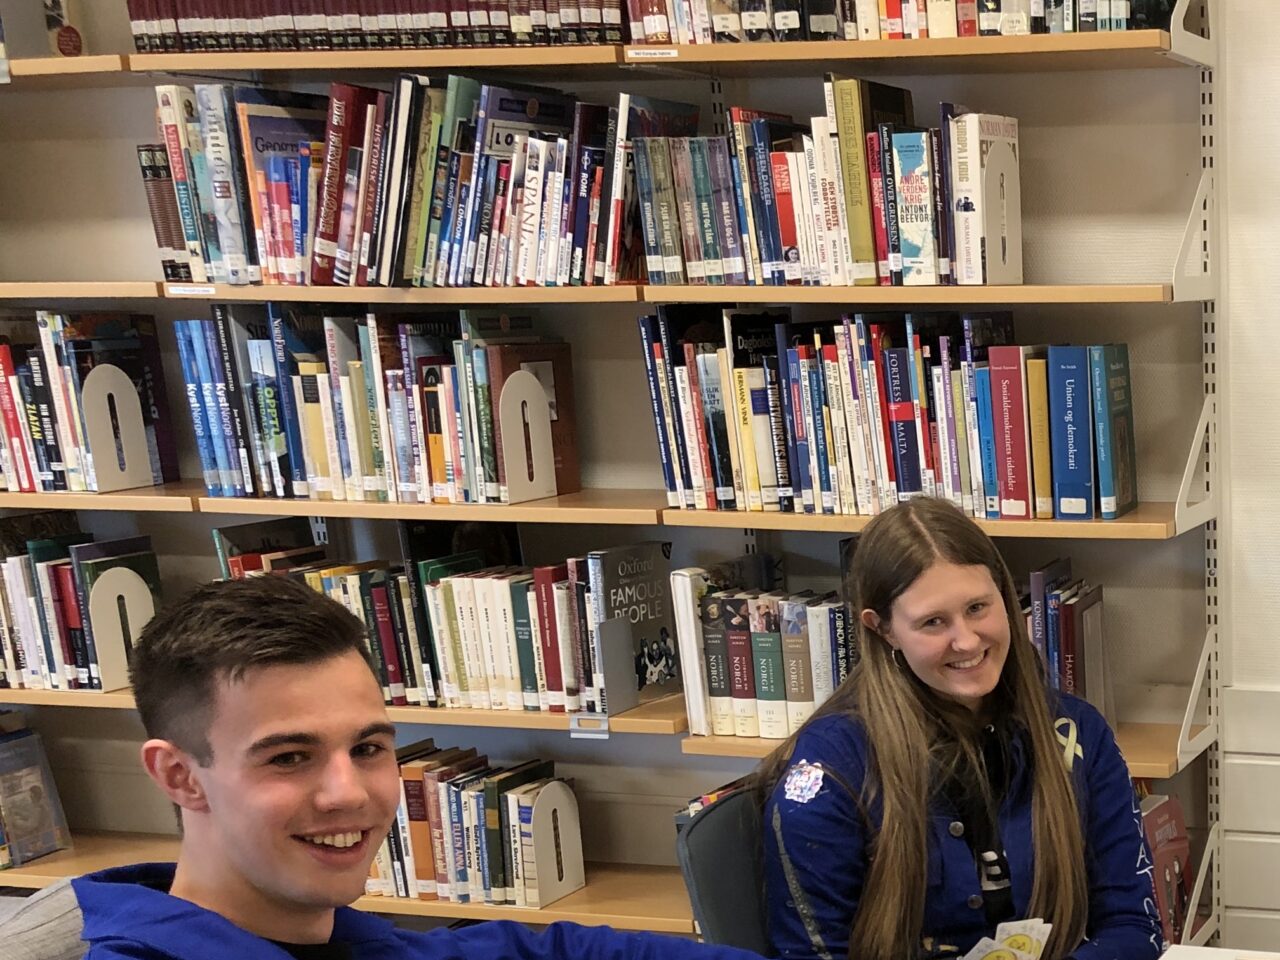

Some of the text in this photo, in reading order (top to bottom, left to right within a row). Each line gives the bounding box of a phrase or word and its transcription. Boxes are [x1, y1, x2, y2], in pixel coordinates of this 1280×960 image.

[578, 172, 589, 198] ROME
[757, 142, 772, 206] TUSEN DAGER
[778, 164, 790, 193] ANNE
[887, 177, 896, 204] OVER
[900, 174, 925, 185] ANDRE
[177, 184, 195, 235] HISTORIE
[447, 176, 456, 209] London
[900, 204, 928, 214] ANTONY
[904, 194, 923, 205] KRIG
[454, 203, 466, 240] LONDON
[889, 204, 899, 247] GRENSEN?
[900, 213, 930, 223] BEEVOR
[326, 328, 336, 358] ERLING
[29, 356, 44, 387] NORTHUG
[186, 383, 205, 437] KystNorge
[202, 383, 219, 437] KystNorge
[215, 382, 233, 437] KystNorge
[264, 387, 280, 435] OPPTU
[736, 371, 749, 426] HERMANN VINKE
[889, 352, 907, 455] FORTRESS MALTA
[26, 403, 43, 440] ZLATAN
[42, 417, 56, 445] HISTORIE
[1001, 379, 1013, 454] Sosialdemokratiets
[1064, 378, 1078, 470] Union og demokrati
[768, 383, 790, 486] TUNGTVANNSAKSJONEN
[1005, 455, 1015, 491] tidsalder
[618, 560, 654, 577] Oxford
[610, 581, 664, 608] FAMOUS
[614, 602, 663, 624] PEOPLE
[1033, 600, 1042, 639] KONGEN
[709, 655, 719, 688] NORGE
[733, 656, 743, 690] NORGE
[759, 658, 769, 692] NORGE
[789, 659, 799, 693] NORGE
[454, 823, 462, 846] ELLEN
